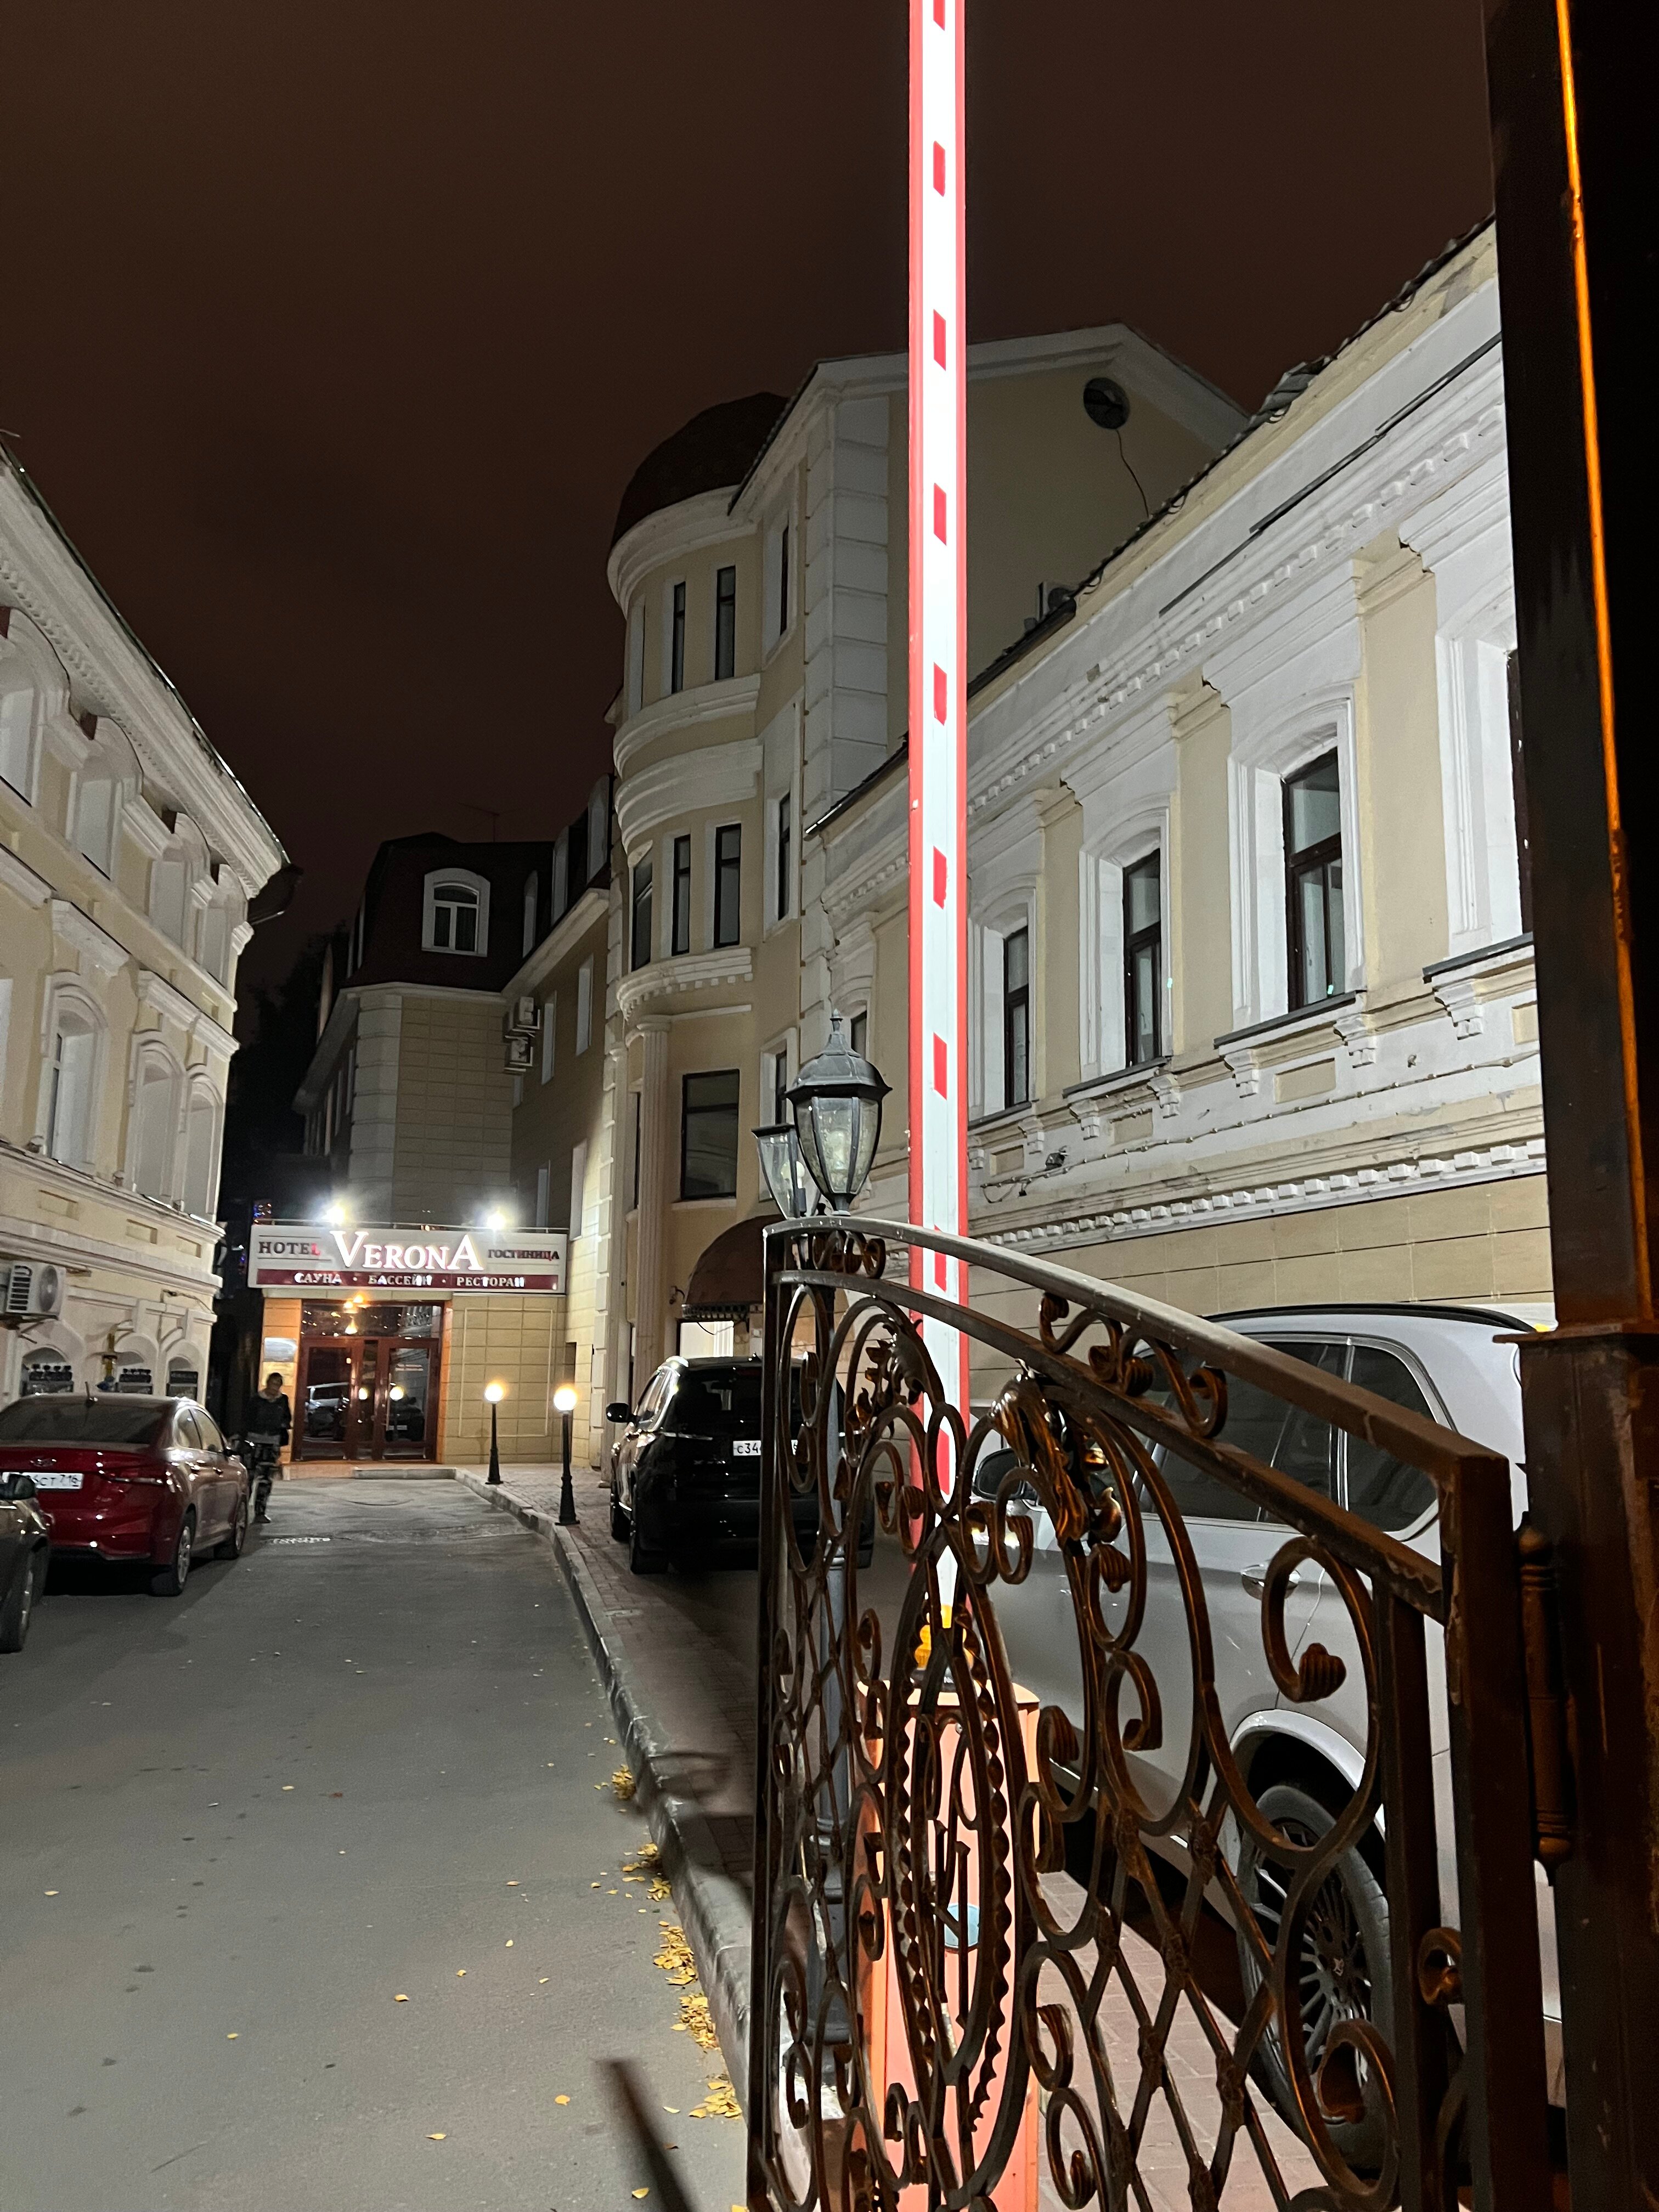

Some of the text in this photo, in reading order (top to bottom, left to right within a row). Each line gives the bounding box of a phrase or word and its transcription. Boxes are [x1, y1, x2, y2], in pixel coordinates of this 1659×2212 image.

[258, 1242, 321, 1255] HOTEL
[329, 1231, 484, 1271] VERONA
[488, 1249, 560, 1261] ГОСТИНИЦА
[294, 1272, 524, 1288] САУНА БАССЕЙН РЕСТОРАН
